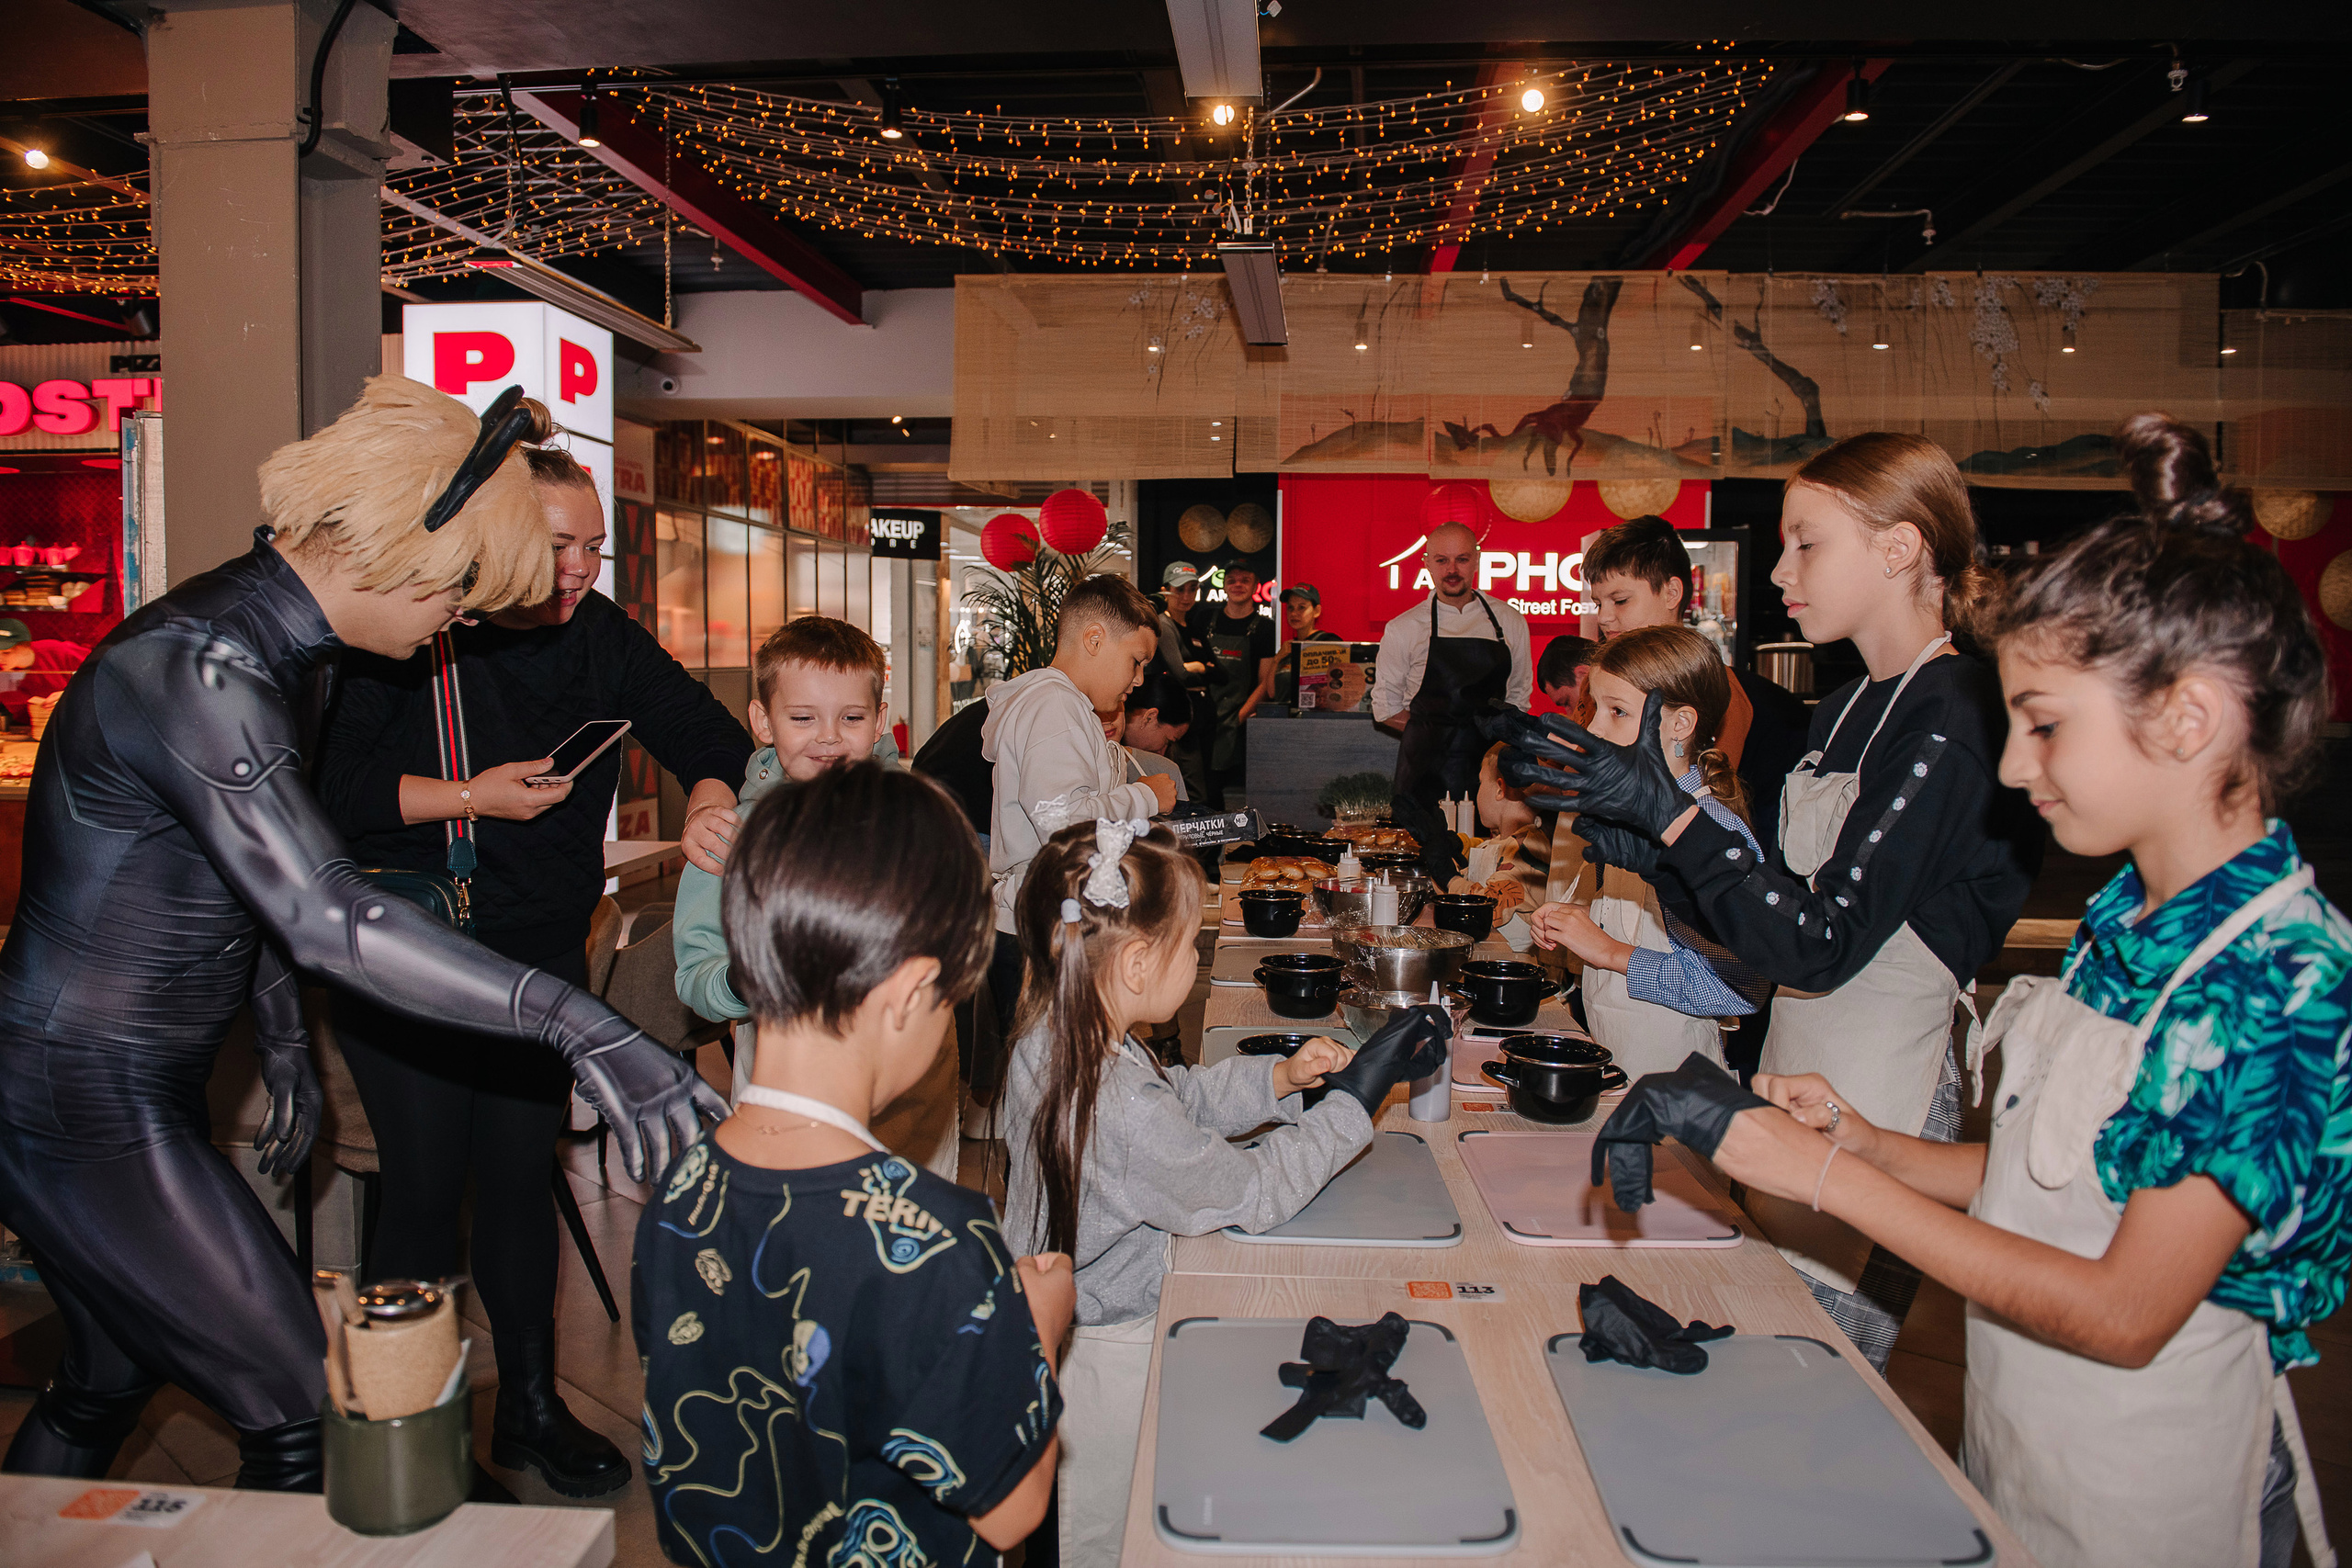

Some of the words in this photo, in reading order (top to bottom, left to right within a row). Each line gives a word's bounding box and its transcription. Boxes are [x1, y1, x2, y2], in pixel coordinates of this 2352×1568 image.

[433, 332, 514, 395] P
[560, 337, 598, 404] P
[1172, 818, 1225, 834] ПЕРЧАТКИ
[1457, 1286, 1496, 1294] 113
